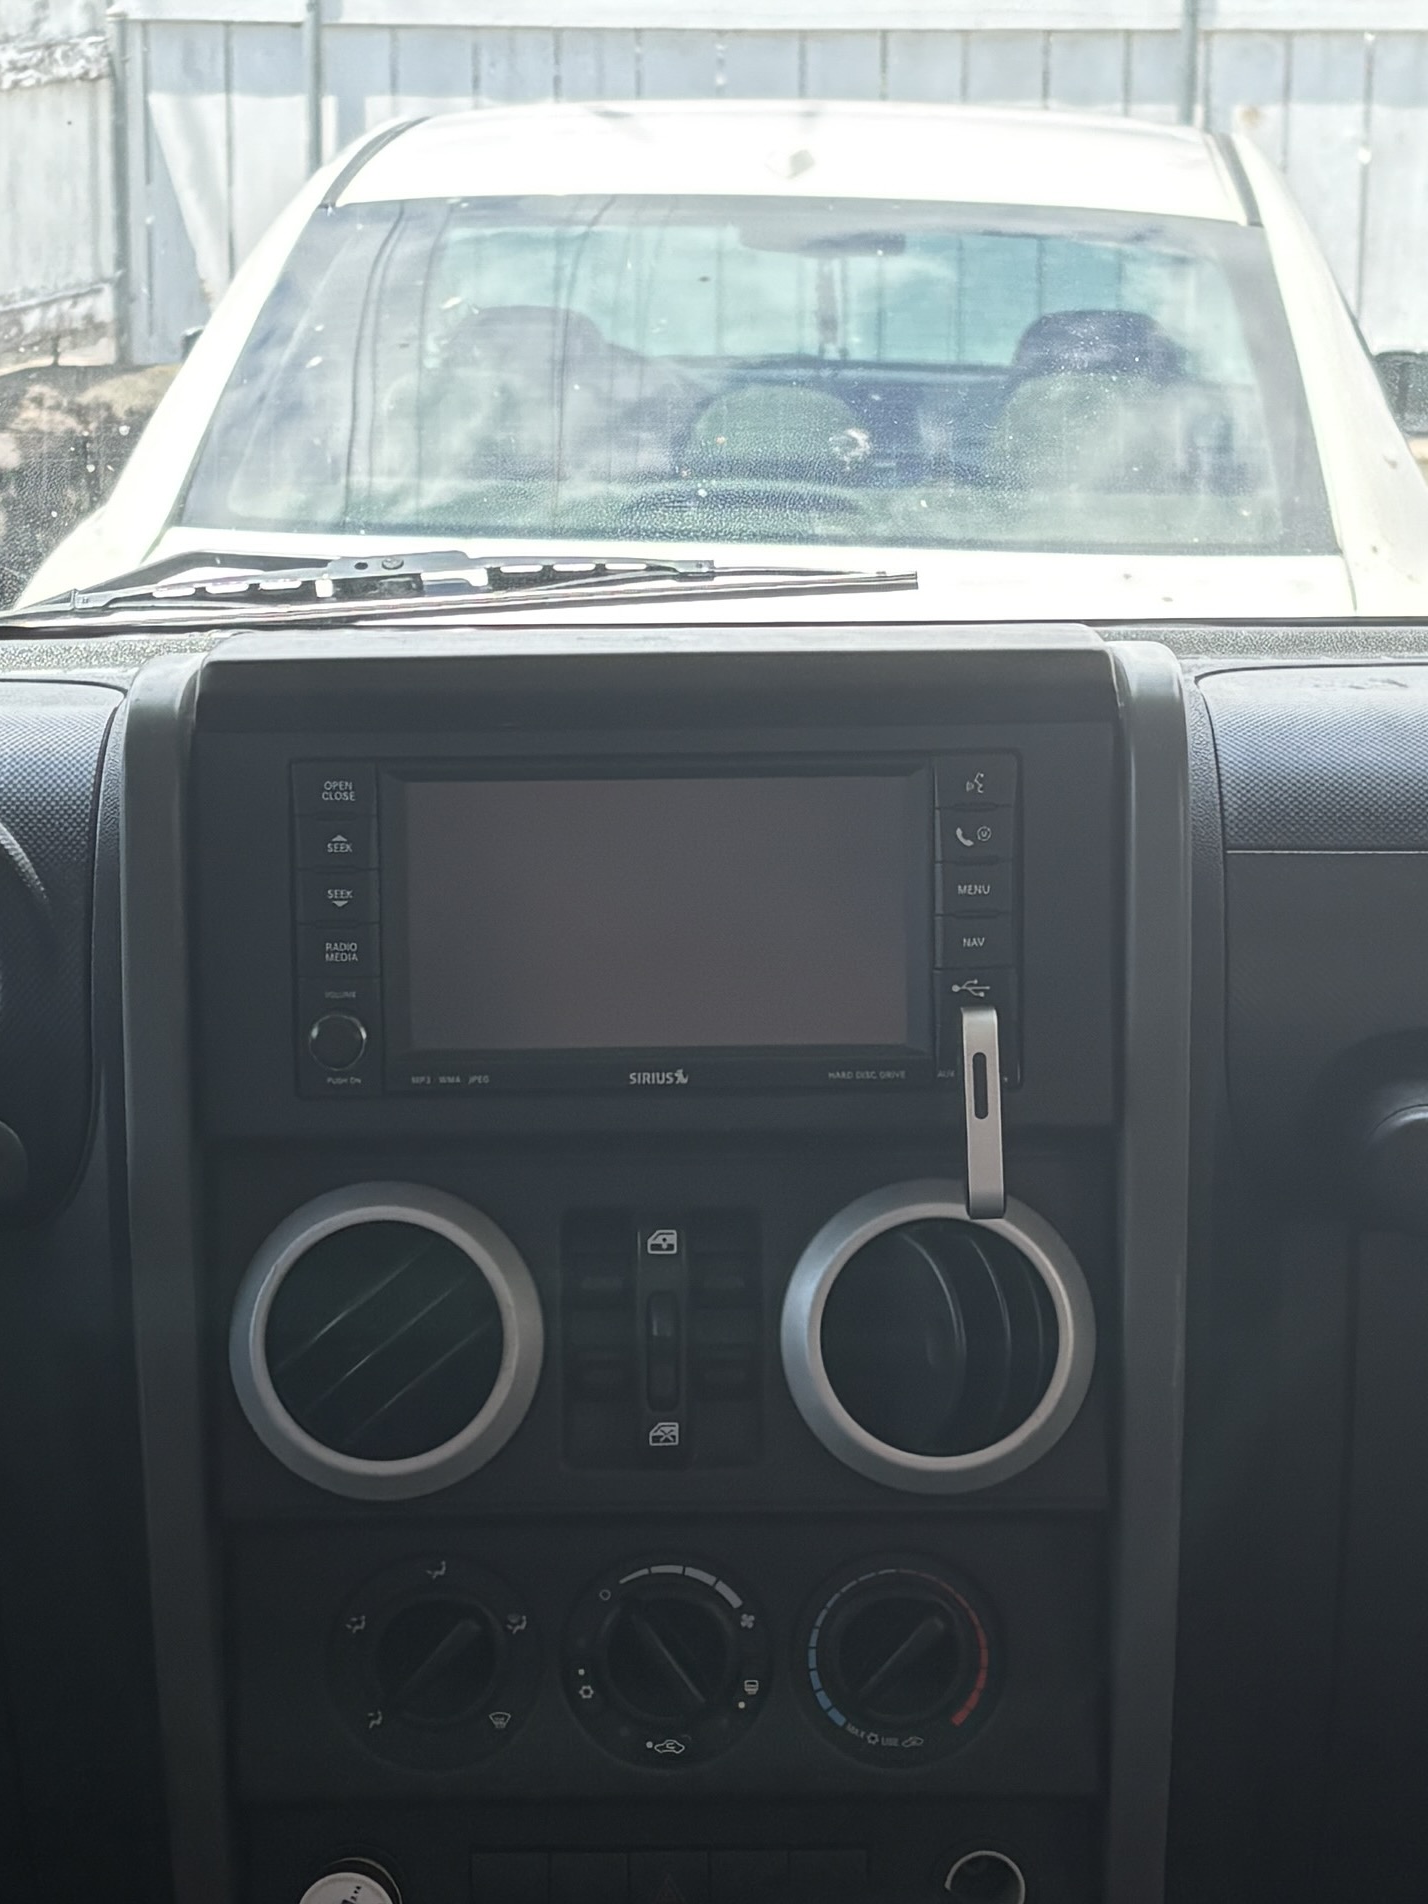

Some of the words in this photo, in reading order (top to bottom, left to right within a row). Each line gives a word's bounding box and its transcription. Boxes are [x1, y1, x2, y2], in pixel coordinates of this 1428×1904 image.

[323, 781, 352, 791] OPEN
[322, 791, 356, 801] CLOSE
[327, 843, 353, 852] SEEK
[327, 889, 353, 899] SEEK
[958, 884, 990, 895] MENU
[325, 942, 358, 952] RADIO
[962, 937, 985, 947] NAV
[325, 953, 359, 962] MEDIA
[629, 1072, 673, 1085] SIRIUS
